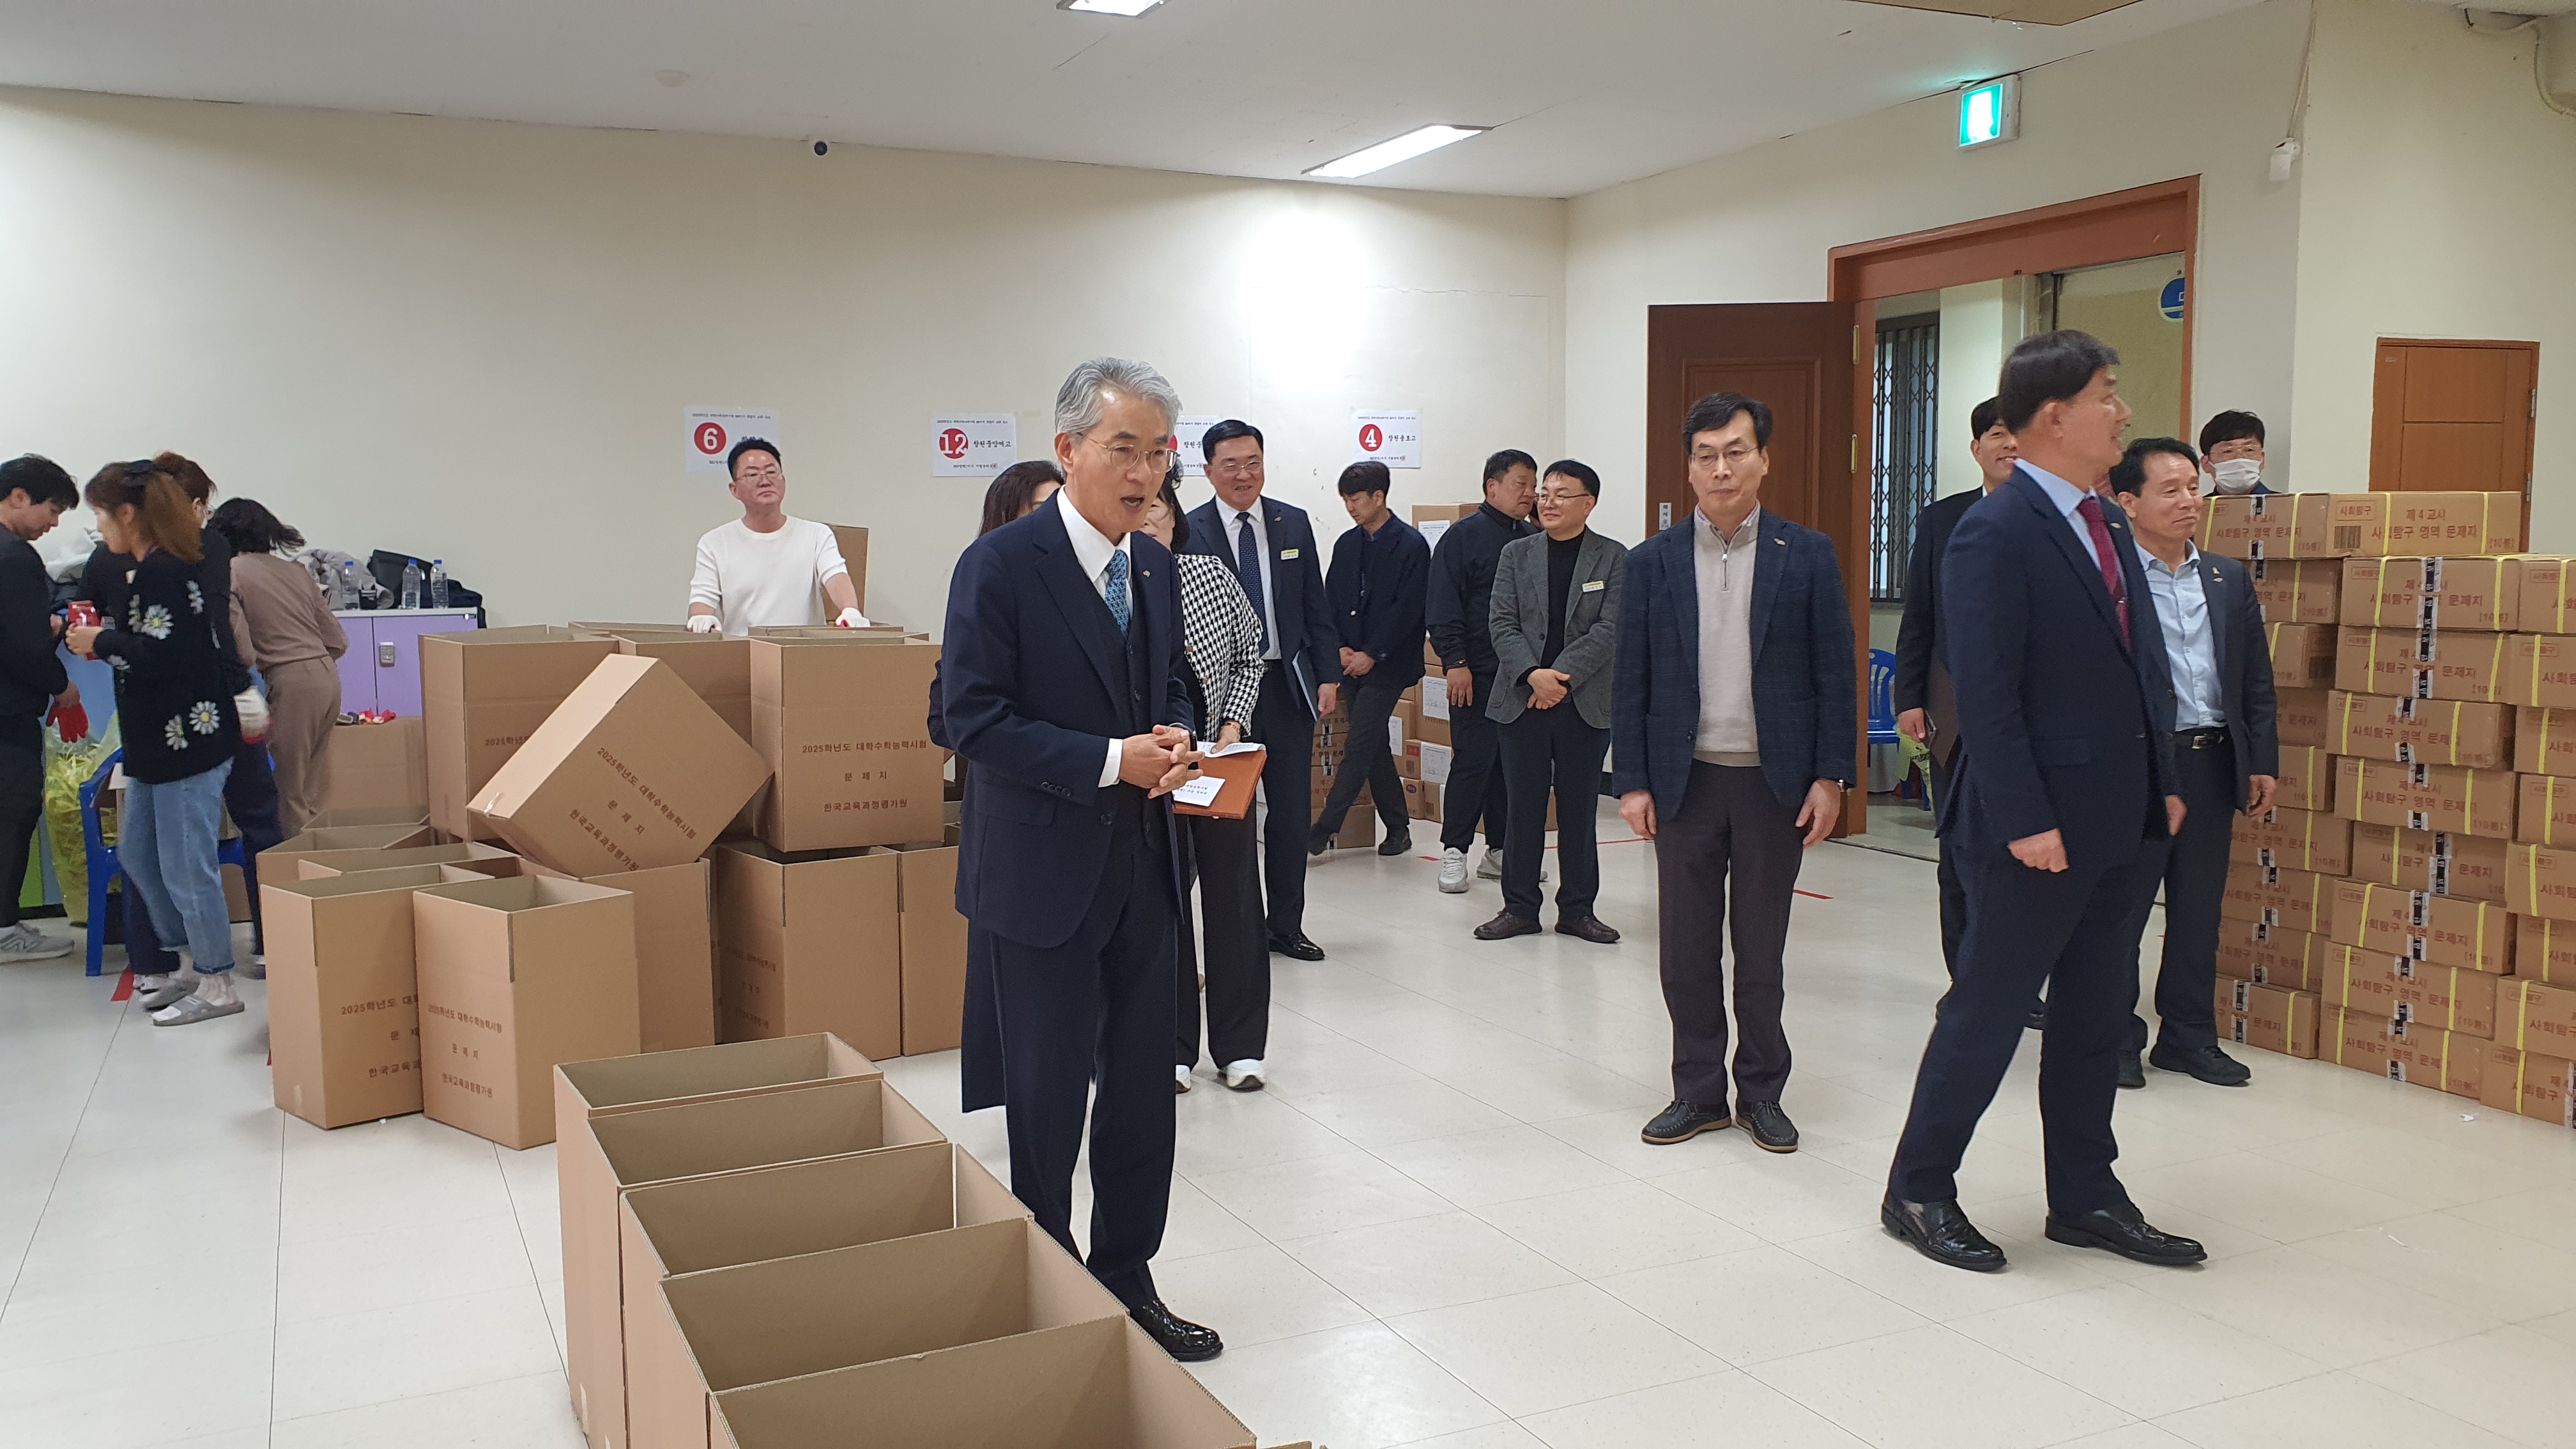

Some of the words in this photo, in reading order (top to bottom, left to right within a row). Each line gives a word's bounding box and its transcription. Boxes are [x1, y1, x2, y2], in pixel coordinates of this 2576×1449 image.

[703, 427, 718, 450] 6
[940, 433, 969, 455] 12
[1365, 428, 1377, 448] 4
[2372, 525, 2414, 539] 사탐구
[2419, 525, 2441, 539] 영역
[2446, 525, 2477, 539] 문제지
[2448, 594, 2483, 607] 문제지
[2442, 665, 2476, 680] 문제지
[2352, 725, 2394, 739] 사회탐구
[2400, 729, 2421, 742] 영역
[802, 743, 852, 753] 2025학년도
[855, 739, 927, 751] 대학수학능력시험
[597, 747, 638, 786] 2025학년도
[638, 784, 698, 840] 대학수학능력시험
[2364, 790, 2407, 805] 사회탐구
[2413, 795, 2435, 808] 영역
[824, 799, 907, 813] 한국교육과정평가원
[569, 809, 640, 871] 한국교육과정평가원
[2380, 854, 2423, 868] 사탐구
[2434, 930, 2468, 947] 문제지
[2350, 978, 2393, 995] 사회탐구
[2400, 987, 2421, 1001] 영역
[341, 998, 397, 1015] 2025학년도
[427, 1004, 456, 1020] 2025학년도
[457, 1011, 503, 1034] 대학수학능력시험
[2345, 1037, 2387, 1054] 사회탐구
[441, 1073, 493, 1098] 한국교육과정평가원
